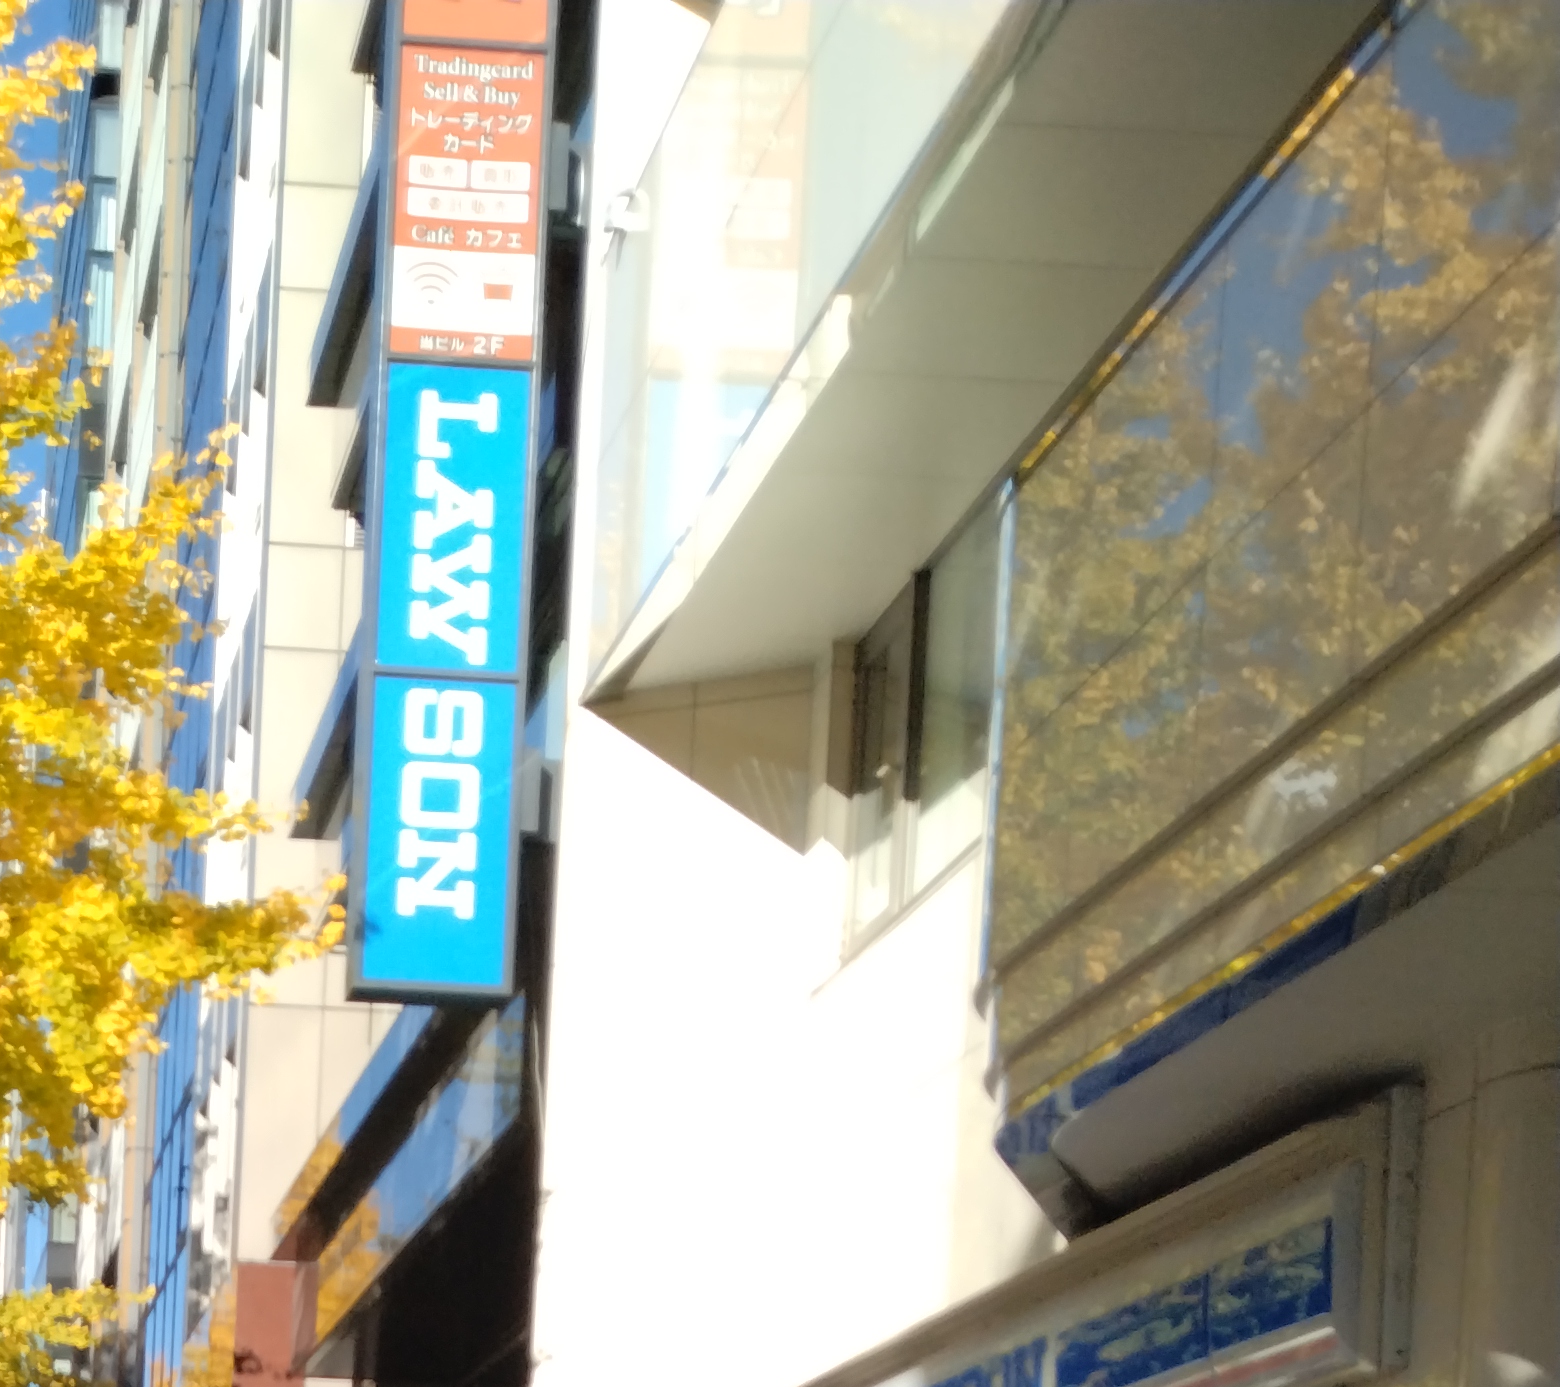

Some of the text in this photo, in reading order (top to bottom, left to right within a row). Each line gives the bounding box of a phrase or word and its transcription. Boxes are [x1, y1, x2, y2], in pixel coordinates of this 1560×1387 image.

[414, 54, 534, 82] Tradingcard
[423, 82, 521, 109] Sell & Buy
[411, 106, 533, 134] トレーディング
[443, 133, 495, 154] カード
[465, 228, 523, 249] カフェ
[472, 335, 506, 357] 2F
